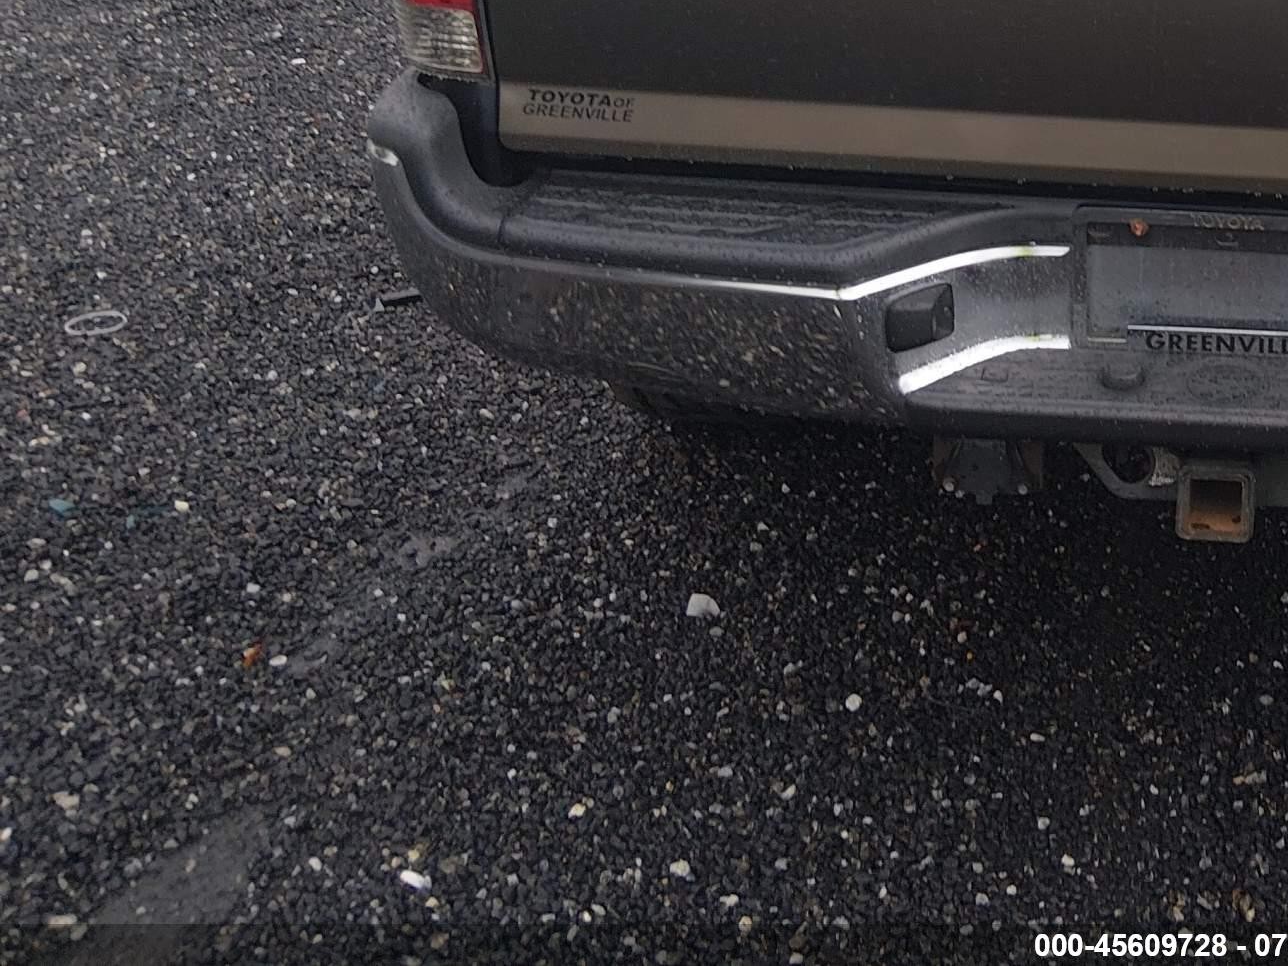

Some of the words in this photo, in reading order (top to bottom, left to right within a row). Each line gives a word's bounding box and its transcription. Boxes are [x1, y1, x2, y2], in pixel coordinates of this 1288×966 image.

[528, 89, 611, 107] TOYOTA
[523, 103, 634, 123] GREENVILLE
[1190, 213, 1265, 232] TOYOTA
